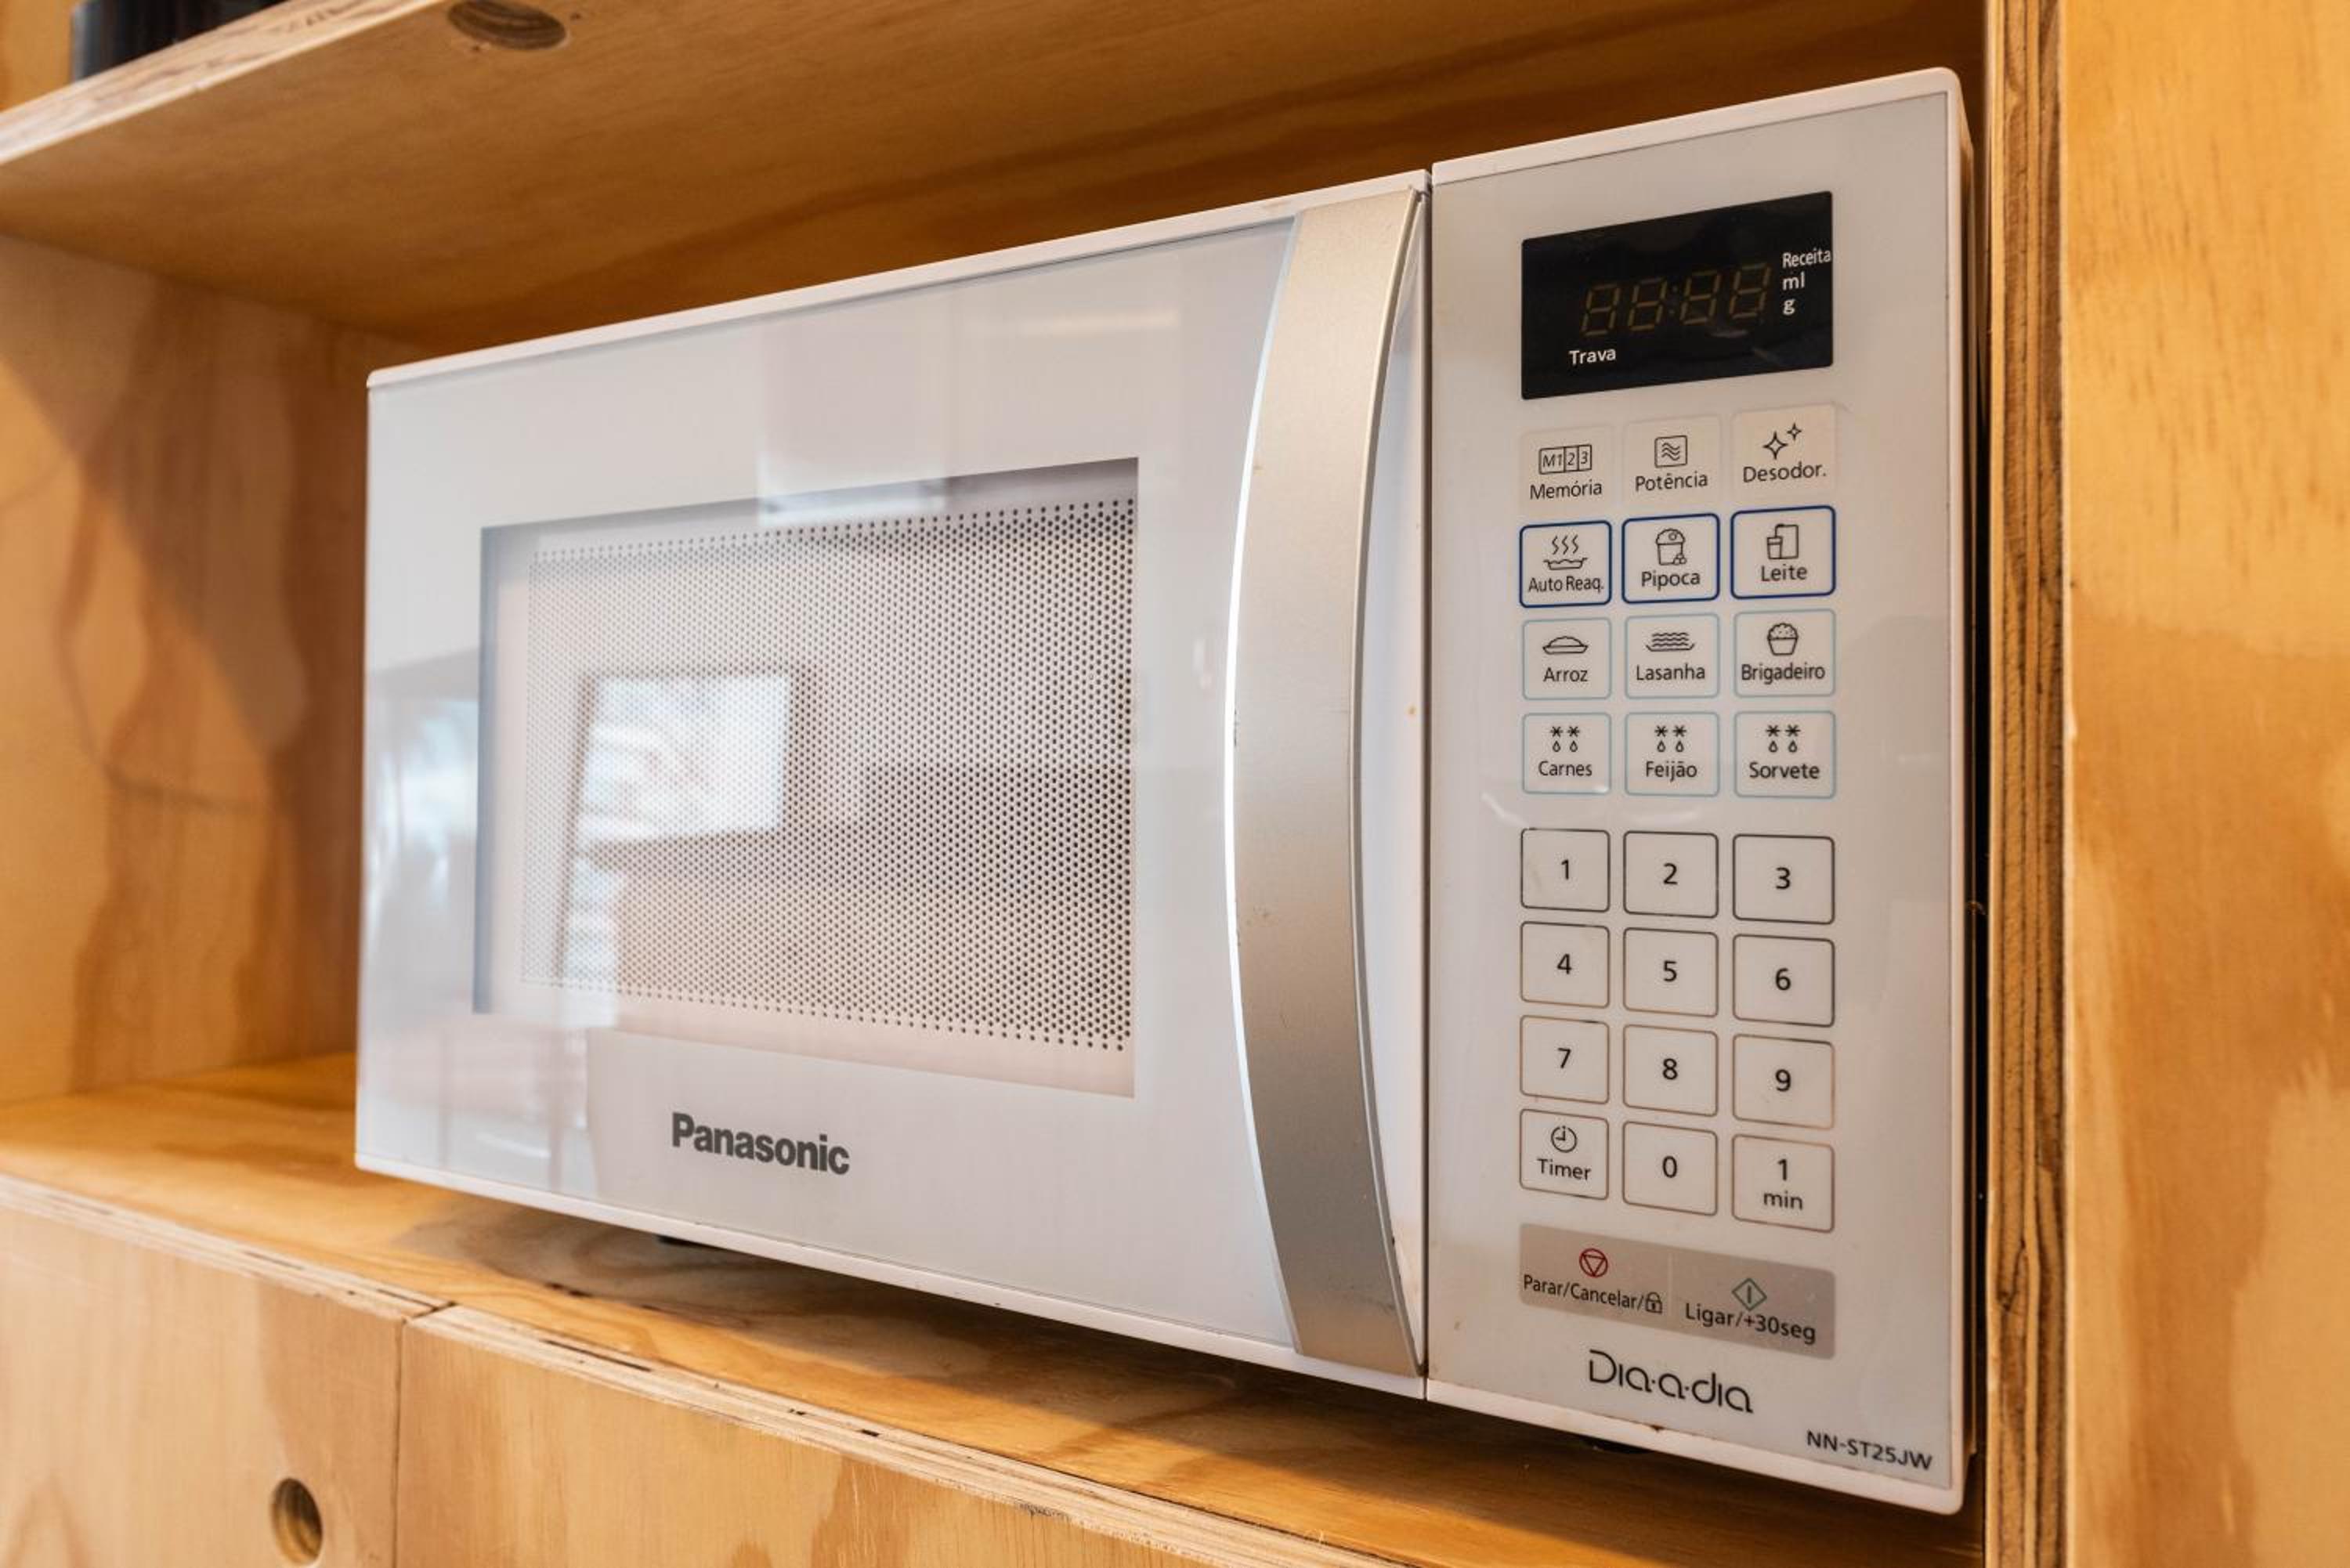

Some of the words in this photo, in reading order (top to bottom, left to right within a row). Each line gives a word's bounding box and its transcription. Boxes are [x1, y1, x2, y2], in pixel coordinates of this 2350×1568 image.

[1782, 248, 1831, 266] Receita
[1782, 273, 1805, 290] ml
[1783, 299, 1795, 315] g
[1569, 348, 1616, 365] Trava
[1636, 473, 1708, 491] Potência
[1743, 462, 1826, 482] Desodor.
[1530, 481, 1602, 500] Memória
[1641, 571, 1700, 591] Pipoca
[1761, 564, 1807, 582] Leite
[1528, 577, 1563, 592] Auto
[1567, 576, 1604, 593] Reaq.
[1543, 667, 1588, 682] Arroz
[1636, 664, 1705, 681] Lasanha
[1741, 663, 1825, 685] Brigadeiro
[1538, 761, 1593, 777] Carnes
[1646, 761, 1697, 782] Feijão
[1749, 763, 1820, 779] Sorvete
[1561, 859, 1569, 880] 1
[1664, 863, 1678, 885] 2
[1776, 867, 1791, 889] 3
[1557, 953, 1572, 974] 4
[1663, 961, 1677, 981] 5
[1776, 968, 1791, 991] 6
[1558, 1048, 1571, 1068] 7
[1663, 1058, 1678, 1080] 8
[1776, 1069, 1791, 1092] 9
[672, 1112, 850, 1176] Panasonic
[1538, 1158, 1591, 1180] Timer
[1662, 1156, 1678, 1178] 0
[1778, 1159, 1788, 1180] 1
[1764, 1191, 1803, 1210] min
[1685, 1303, 1816, 1345] Ligar/+30seg
[1806, 1429, 1932, 1470] NN-ST25JW
